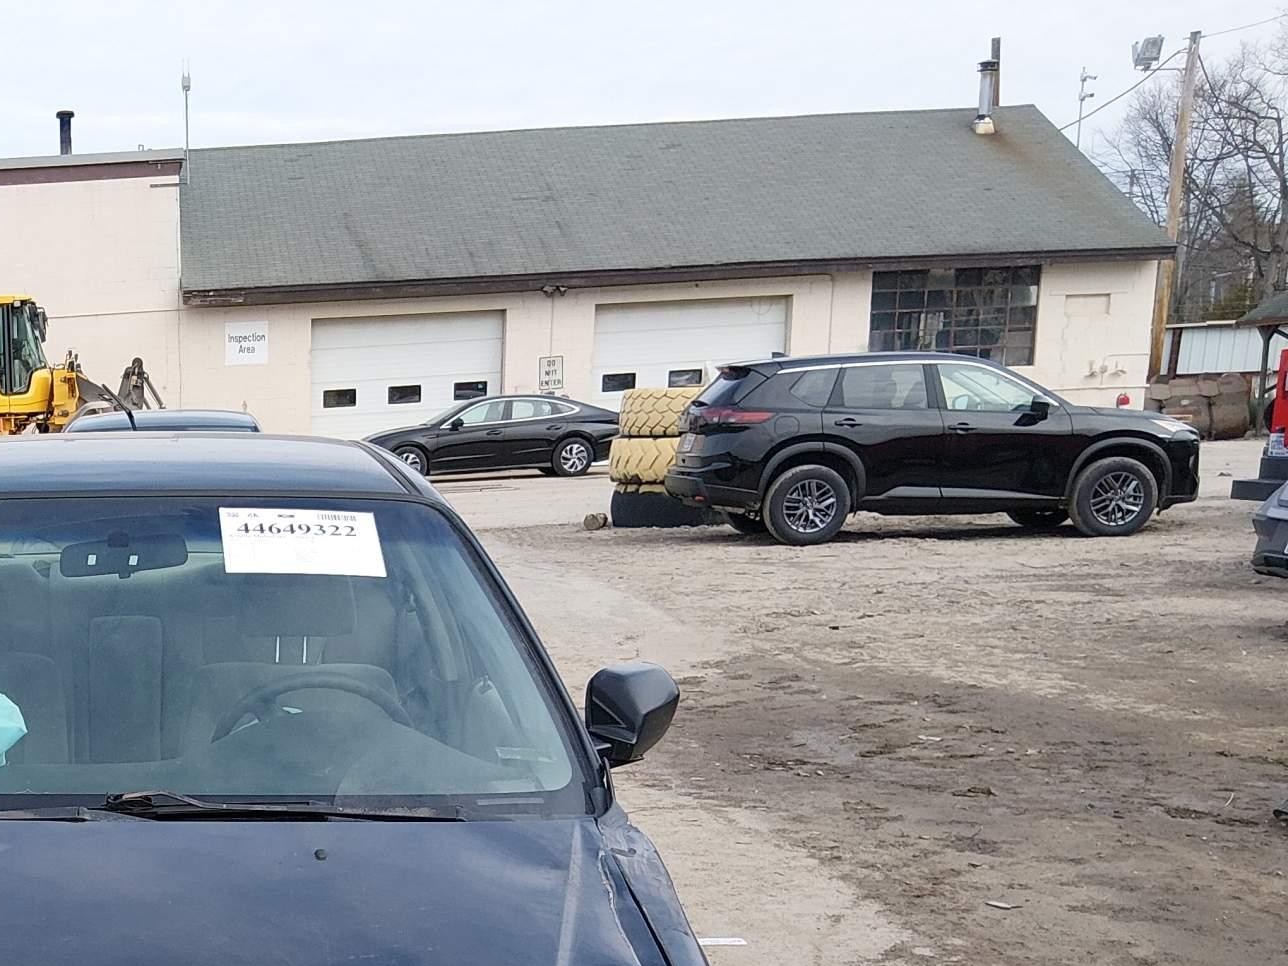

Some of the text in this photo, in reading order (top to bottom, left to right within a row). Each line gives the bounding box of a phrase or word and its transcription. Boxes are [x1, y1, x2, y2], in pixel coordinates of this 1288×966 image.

[227, 332, 266, 344] Inspection
[238, 344, 256, 354] Area
[236, 522, 357, 537] 44649322
